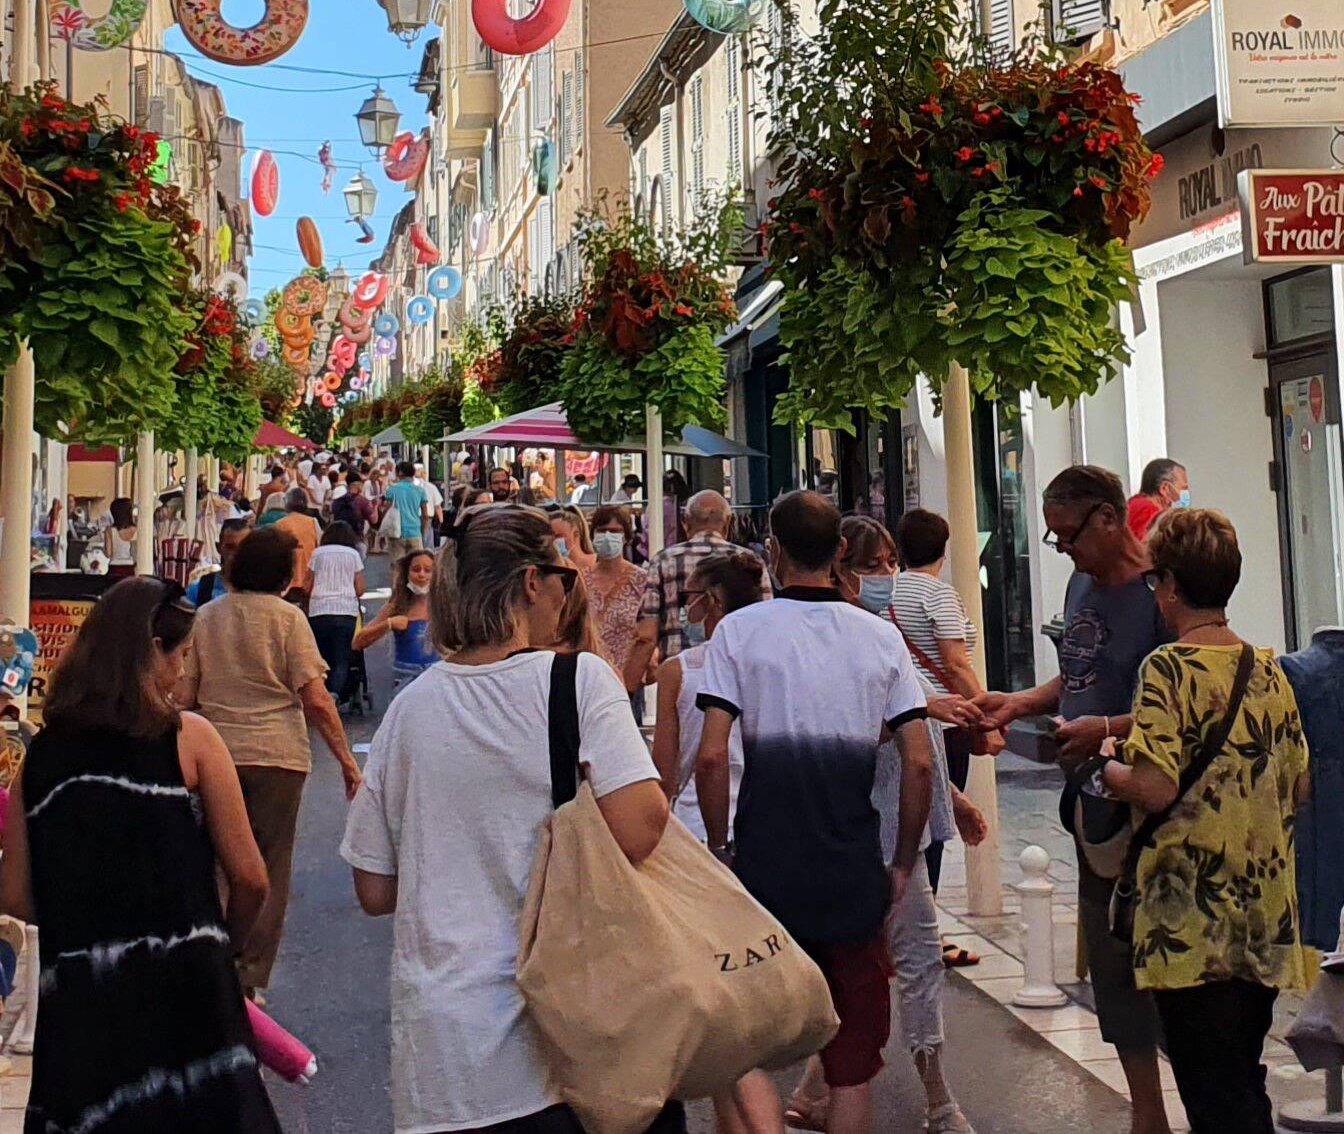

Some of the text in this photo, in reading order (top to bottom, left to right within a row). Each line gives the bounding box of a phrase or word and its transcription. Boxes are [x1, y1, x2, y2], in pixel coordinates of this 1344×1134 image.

[1231, 31, 1294, 51] ROYAL
[1178, 164, 1222, 220] ROYAL
[1259, 185, 1302, 211] Aux
